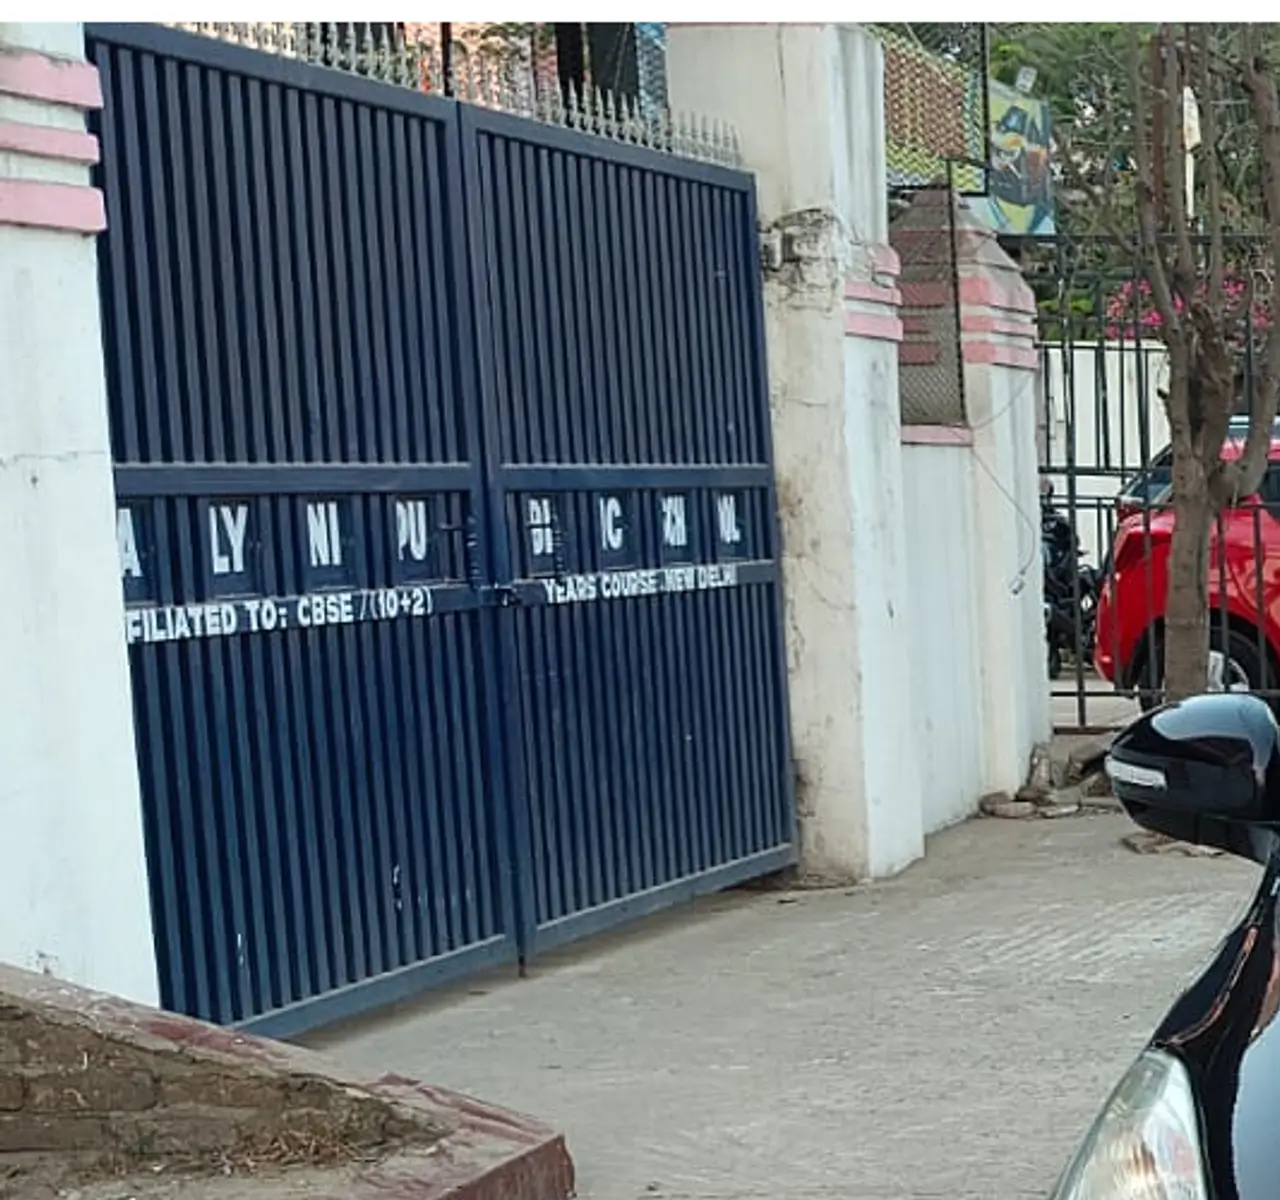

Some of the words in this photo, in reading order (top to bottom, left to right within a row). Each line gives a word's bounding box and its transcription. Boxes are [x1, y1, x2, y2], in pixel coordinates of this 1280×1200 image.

[209, 505, 248, 575] LY
[541, 575, 598, 605] YEARS
[601, 570, 657, 600] COURSE
[297, 592, 355, 627] CBSE
